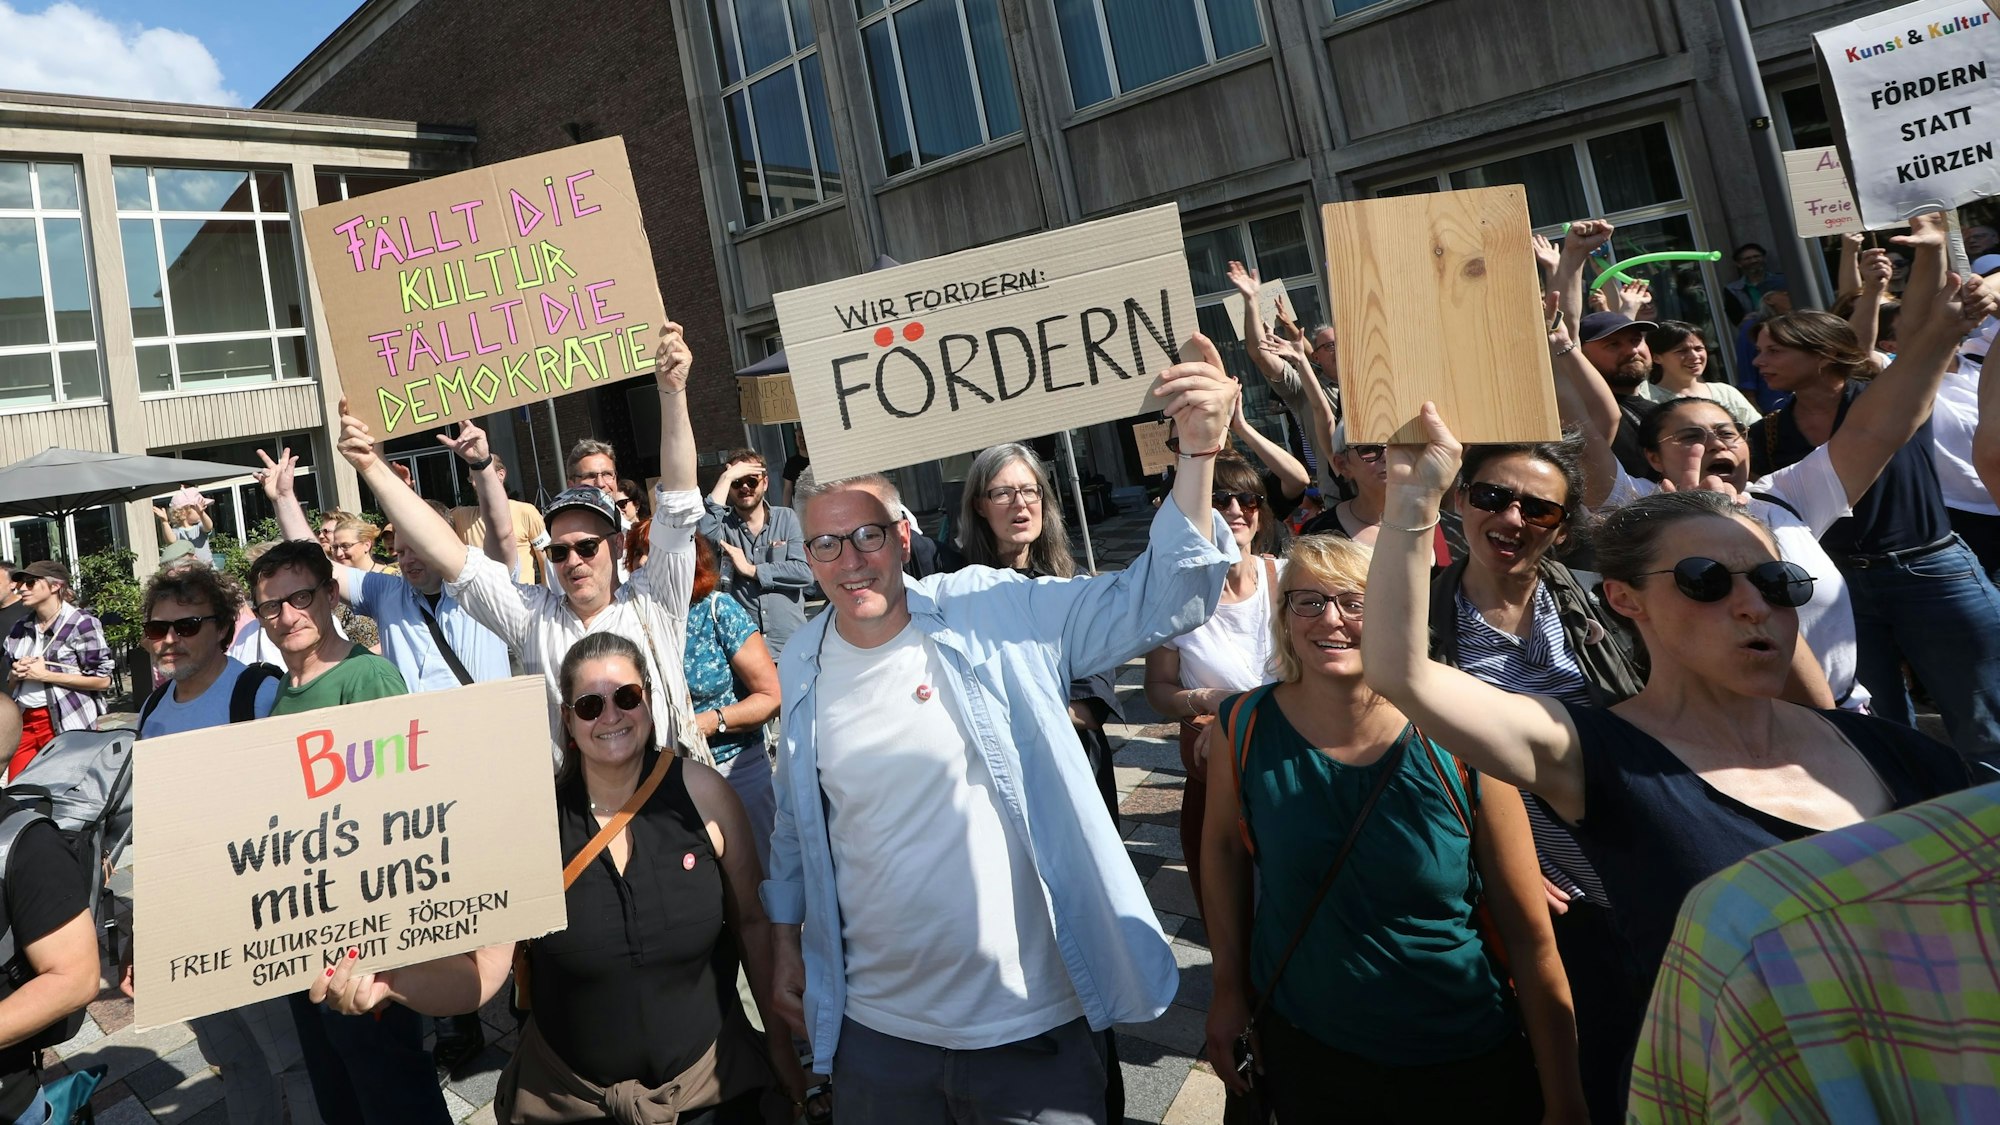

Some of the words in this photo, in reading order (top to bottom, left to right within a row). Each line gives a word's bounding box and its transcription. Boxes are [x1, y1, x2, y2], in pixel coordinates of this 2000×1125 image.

[1845, 36, 1903, 63] Kunst
[1907, 29, 1924, 45] &
[1927, 12, 1990, 39] Kultur
[1871, 61, 1987, 110] FÖRDERN
[1901, 106, 1972, 142] STATT
[1896, 142, 1993, 184] KÜRZEN
[333, 200, 483, 272] FÄLLT
[1804, 198, 1852, 216] Freie
[1824, 216, 1853, 229] gegen
[399, 240, 577, 313] KULTUR
[834, 298, 899, 330] WIR
[905, 268, 1046, 312] FORDERN:
[368, 300, 523, 378] FÄLLT
[831, 288, 1182, 431] FÖRDERN
[297, 719, 430, 800] Bunt
[227, 804, 360, 876] wird's
[383, 800, 457, 846] nur
[251, 868, 339, 931] mit
[360, 836, 451, 903] uns!
[169, 947, 232, 983] FREIE
[243, 912, 392, 964] KULTURSZENE
[409, 890, 509, 926] FÖRDERN
[252, 953, 312, 987] STATT
[397, 914, 479, 951] SPAREN!
